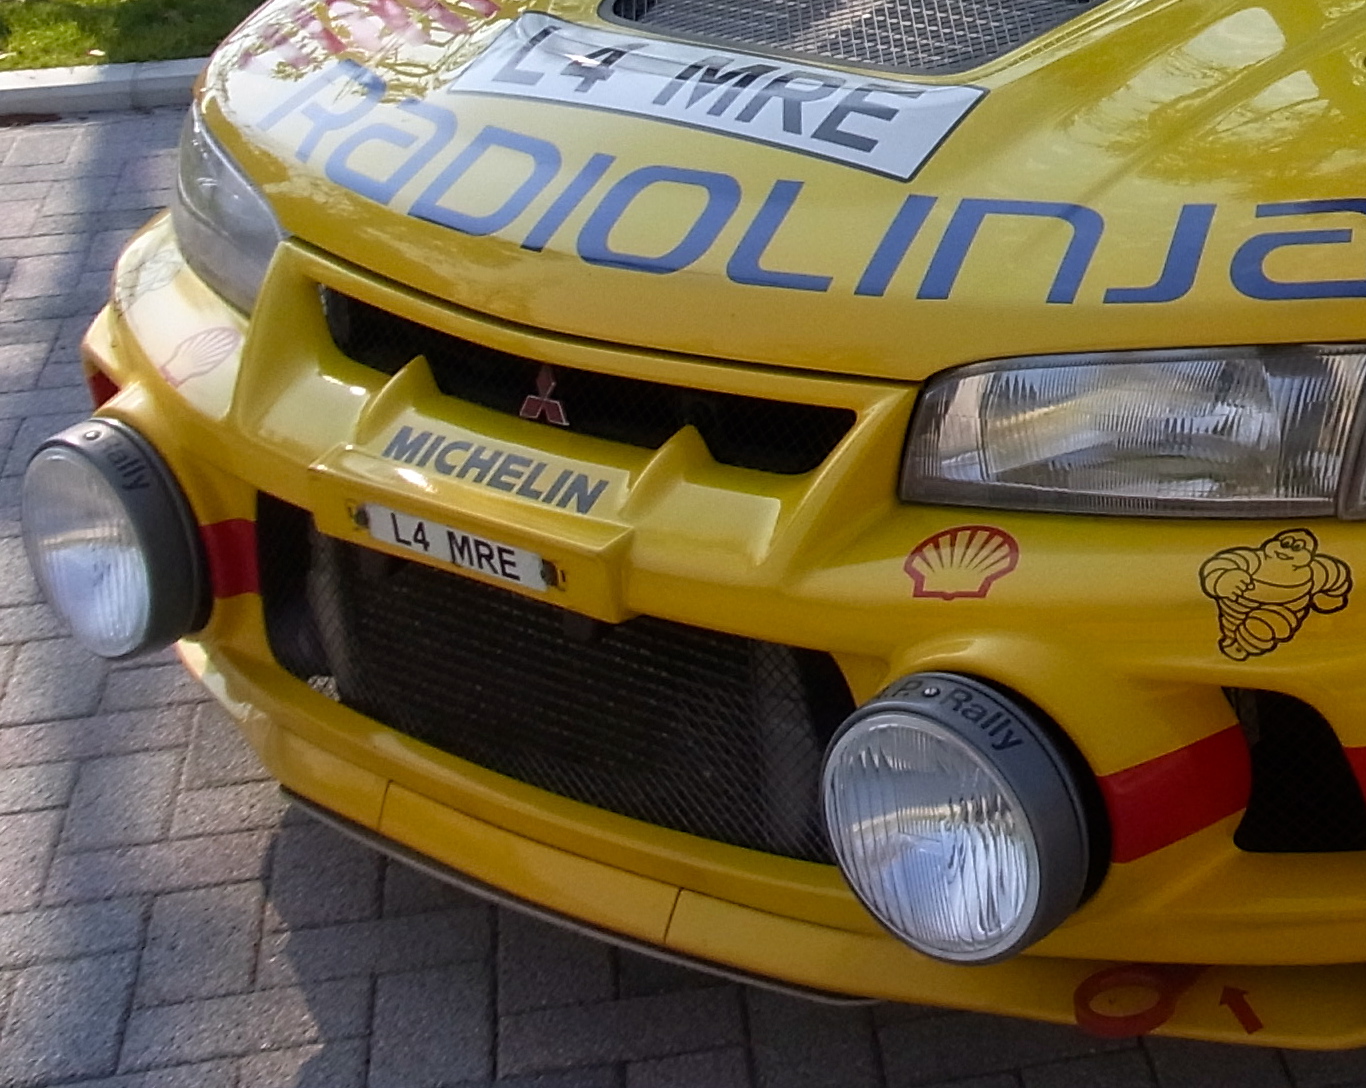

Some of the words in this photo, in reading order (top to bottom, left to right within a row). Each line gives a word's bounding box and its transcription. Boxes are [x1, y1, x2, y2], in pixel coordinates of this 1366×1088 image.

[492, 25, 640, 94] L4
[655, 56, 898, 152] MRE
[382, 426, 609, 514] MICHELIN
[390, 513, 430, 552] L4
[447, 531, 521, 581] MRE
[940, 688, 1024, 750] Rally
